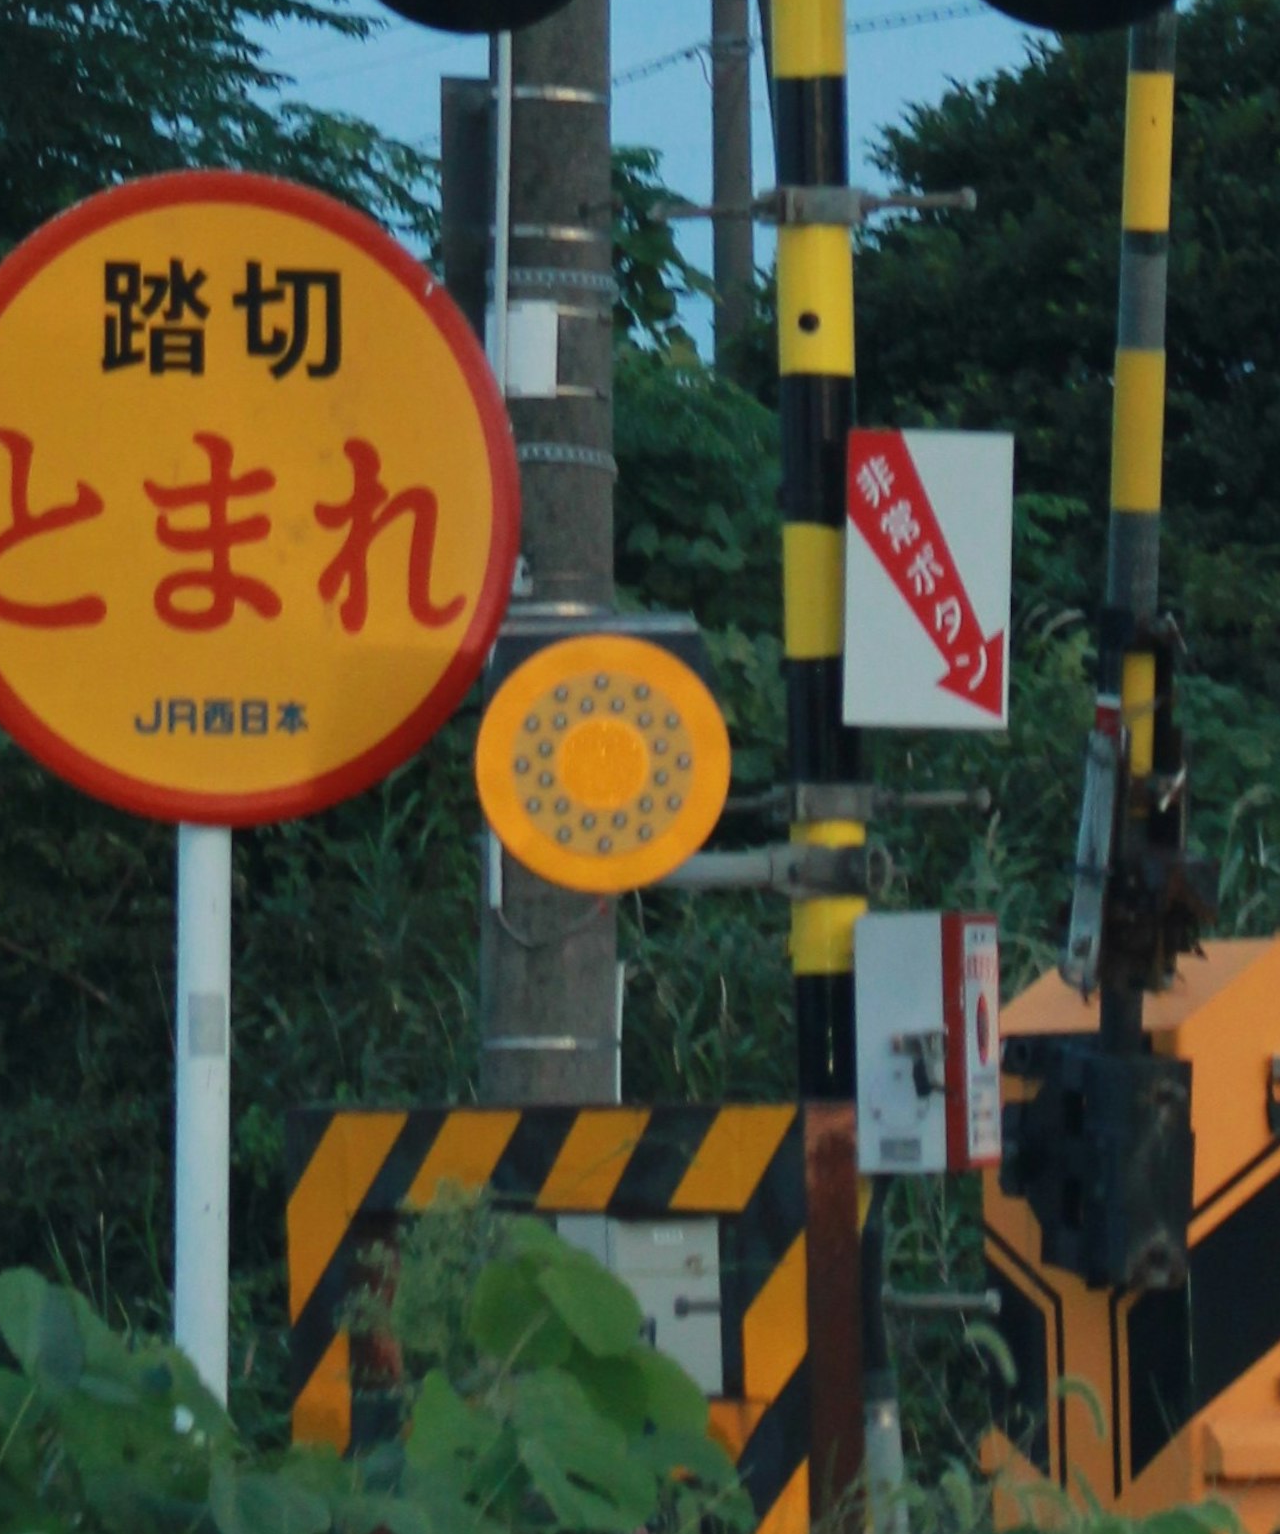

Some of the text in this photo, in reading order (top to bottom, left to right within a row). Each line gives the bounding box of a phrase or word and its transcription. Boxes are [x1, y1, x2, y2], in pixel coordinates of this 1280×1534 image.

[102, 257, 342, 380] 踏切
[856, 455, 987, 692] 非常ボタン
[134, 696, 309, 736] JR西日本
